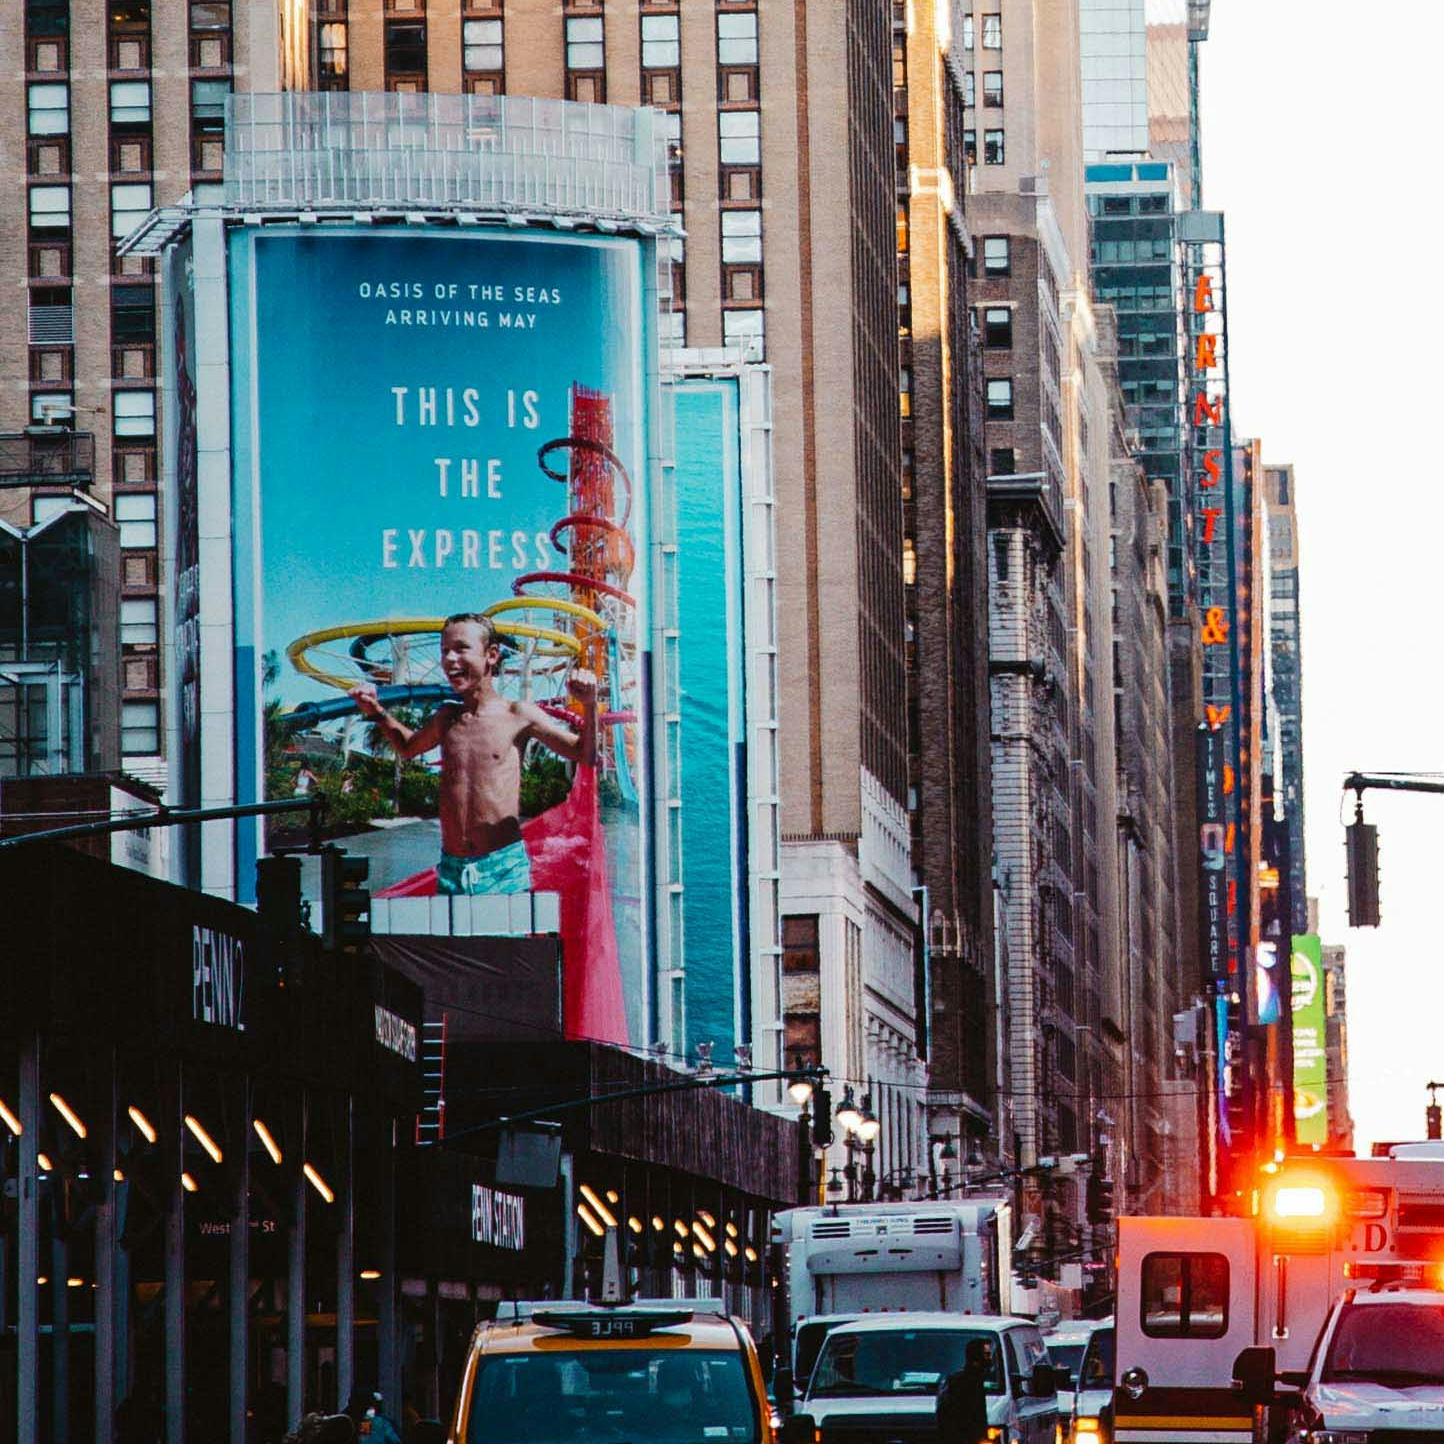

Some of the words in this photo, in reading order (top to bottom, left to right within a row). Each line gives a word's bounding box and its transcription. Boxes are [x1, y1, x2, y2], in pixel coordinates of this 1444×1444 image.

[359, 282, 423, 299] OASIS
[434, 283, 458, 299] OF
[469, 284, 504, 301] THE
[514, 286, 561, 304] SEAS
[385, 310, 489, 328] ARRIVING
[499, 312, 537, 329] MAY
[391, 386, 480, 427] THIS
[507, 389, 540, 429] IS
[1194, 275, 1221, 544] ERNST
[434, 458, 504, 499] THE
[382, 528, 551, 570] EXPRESS
[1201, 607, 1229, 645] &
[193, 924, 234, 1028] PENN
[200, 1221, 231, 1235] West
[263, 1220, 276, 1232] St
[472, 1183, 492, 1244] PENN
[493, 1190, 524, 1251] STATION
